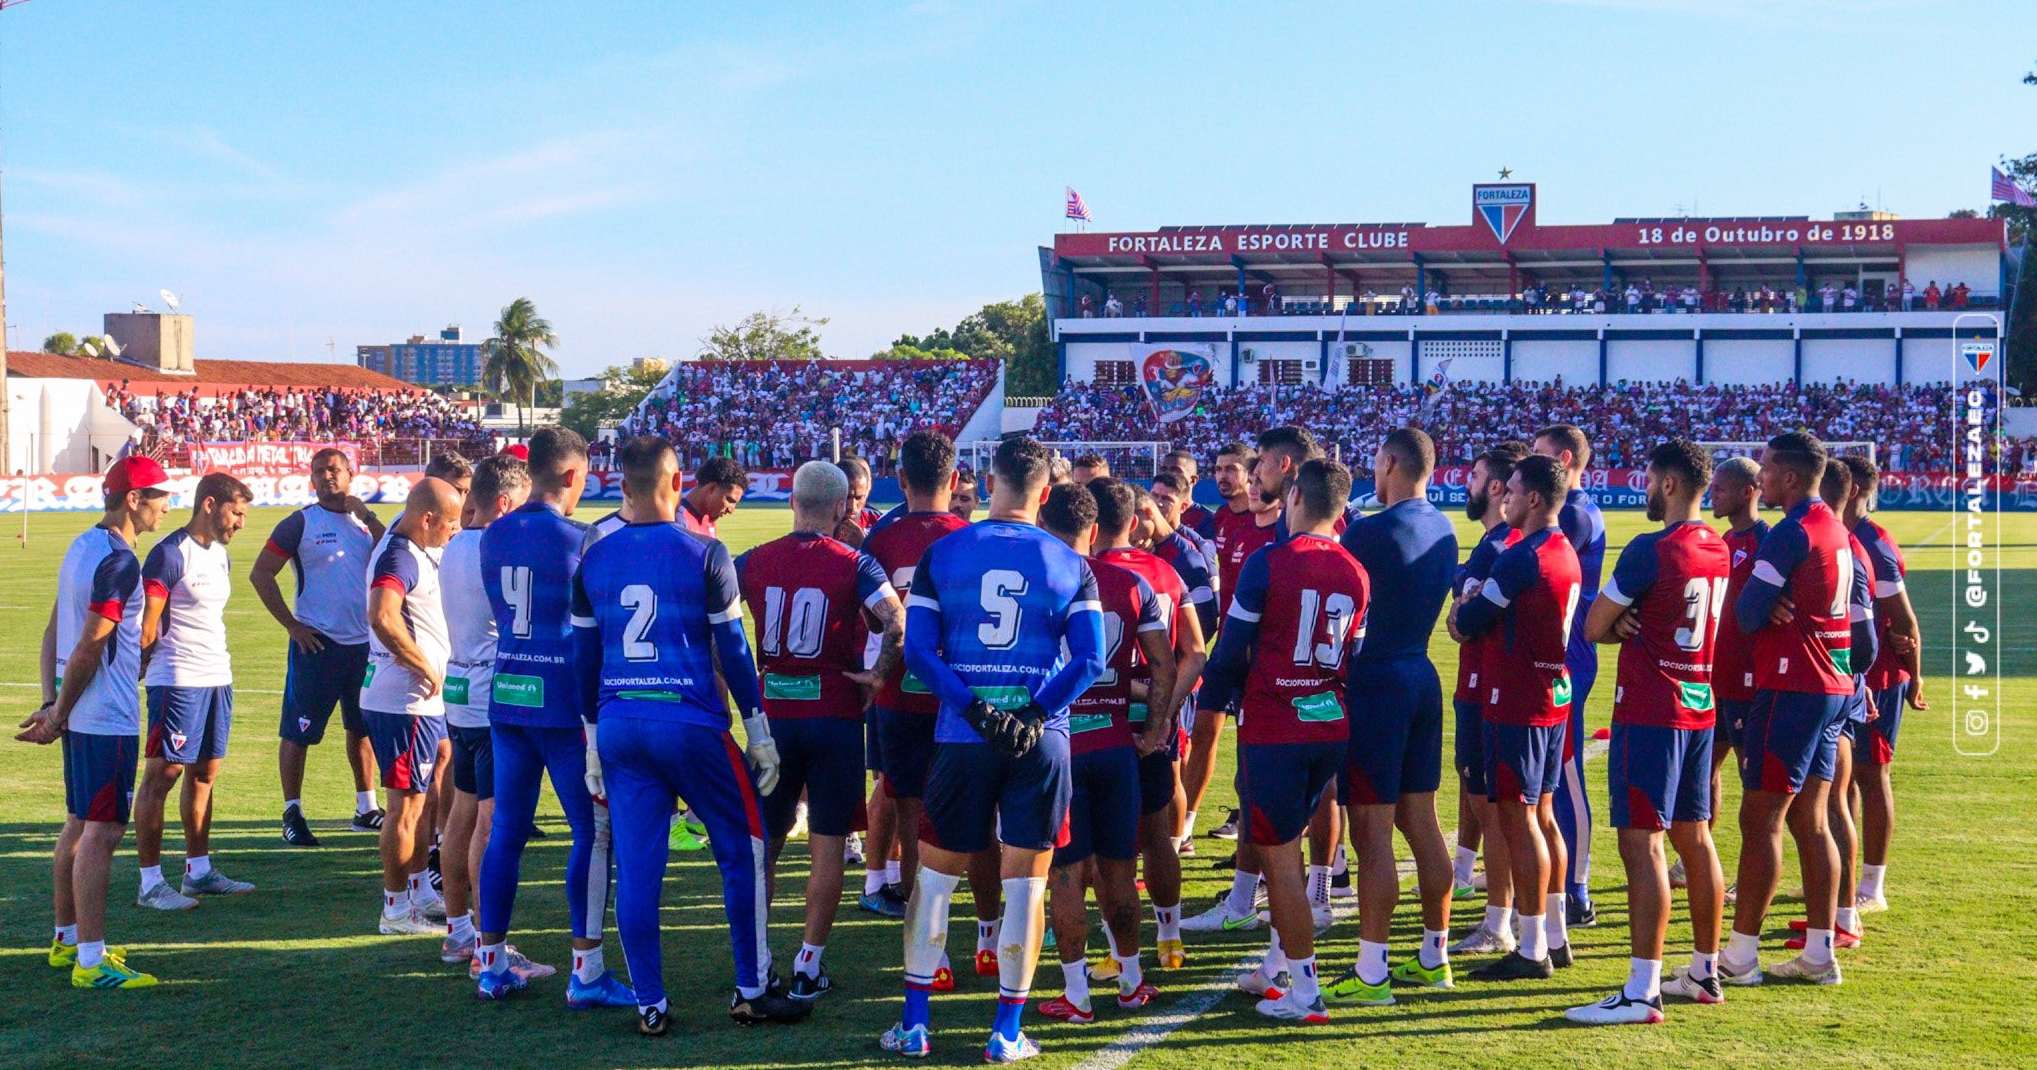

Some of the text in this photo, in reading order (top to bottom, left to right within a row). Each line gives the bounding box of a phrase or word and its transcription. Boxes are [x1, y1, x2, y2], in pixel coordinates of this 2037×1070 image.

[1477, 189, 1529, 200] FORTALEZA
[1108, 231, 1409, 252] FORTALEZA ESPORTE CLUBE
[1638, 223, 1895, 244] 18 de Outubro de 1918
[501, 565, 533, 640] 4
[620, 584, 659, 662] 2
[762, 586, 829, 659] 10
[977, 568, 1029, 650] 5
[1293, 588, 1357, 670] 13
